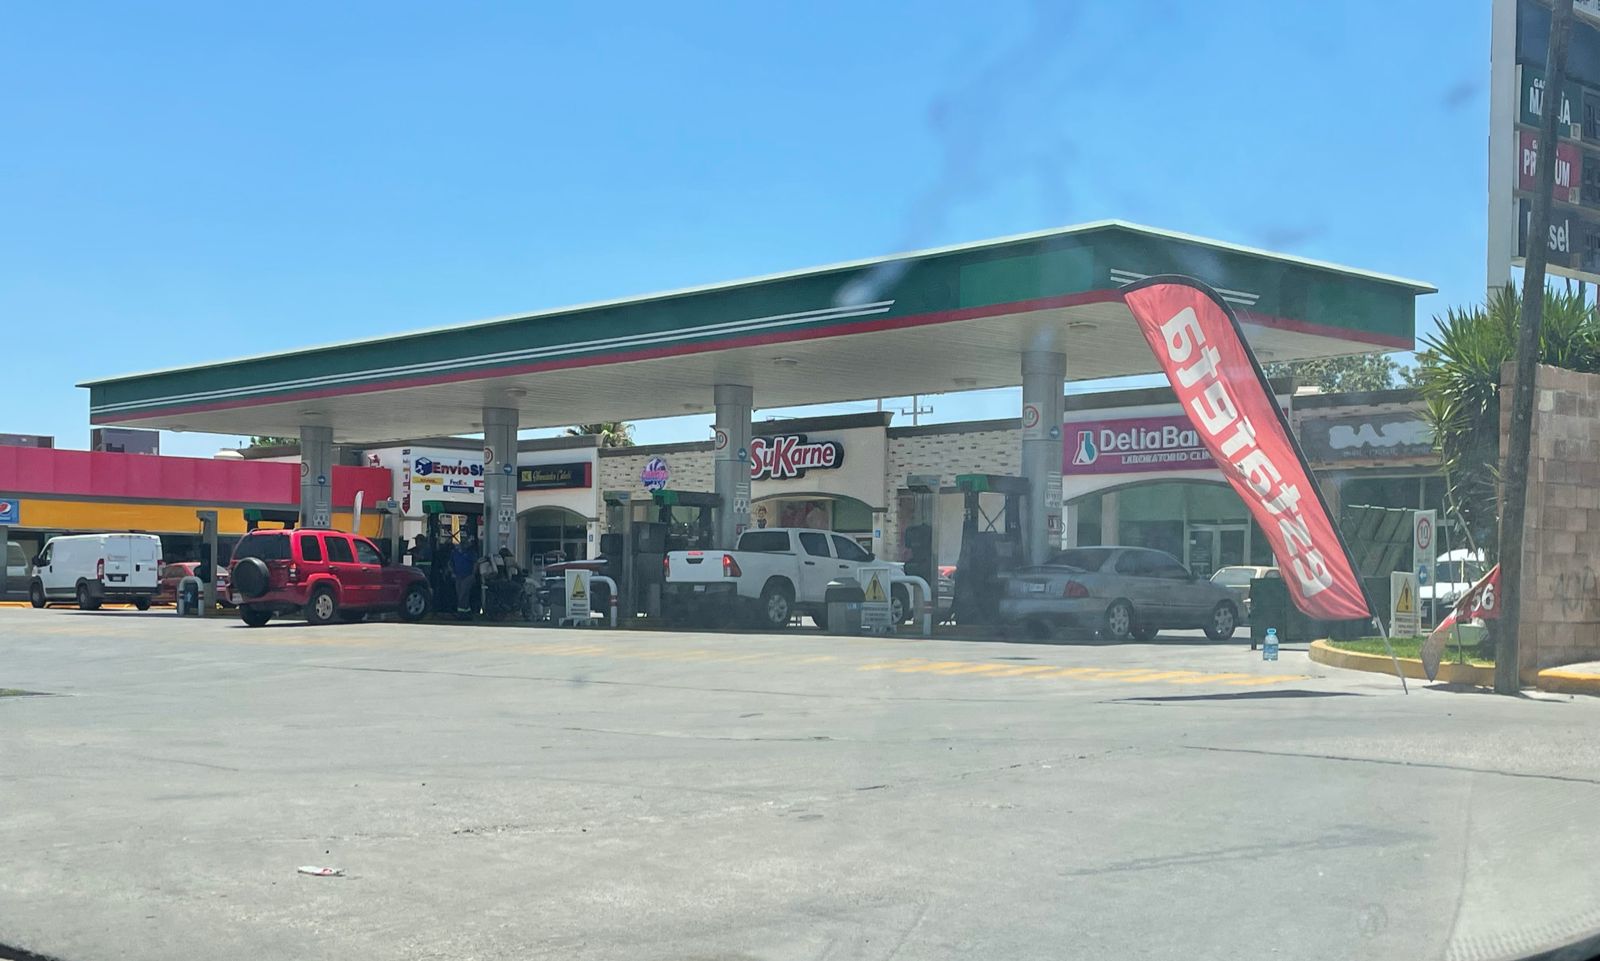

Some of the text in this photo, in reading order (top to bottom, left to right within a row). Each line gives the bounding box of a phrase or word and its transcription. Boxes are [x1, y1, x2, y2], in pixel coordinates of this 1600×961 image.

[1523, 148, 1570, 188] PRUM
[751, 435, 836, 479] SuKarne
[1121, 452, 1188, 464] LABORATORIO
